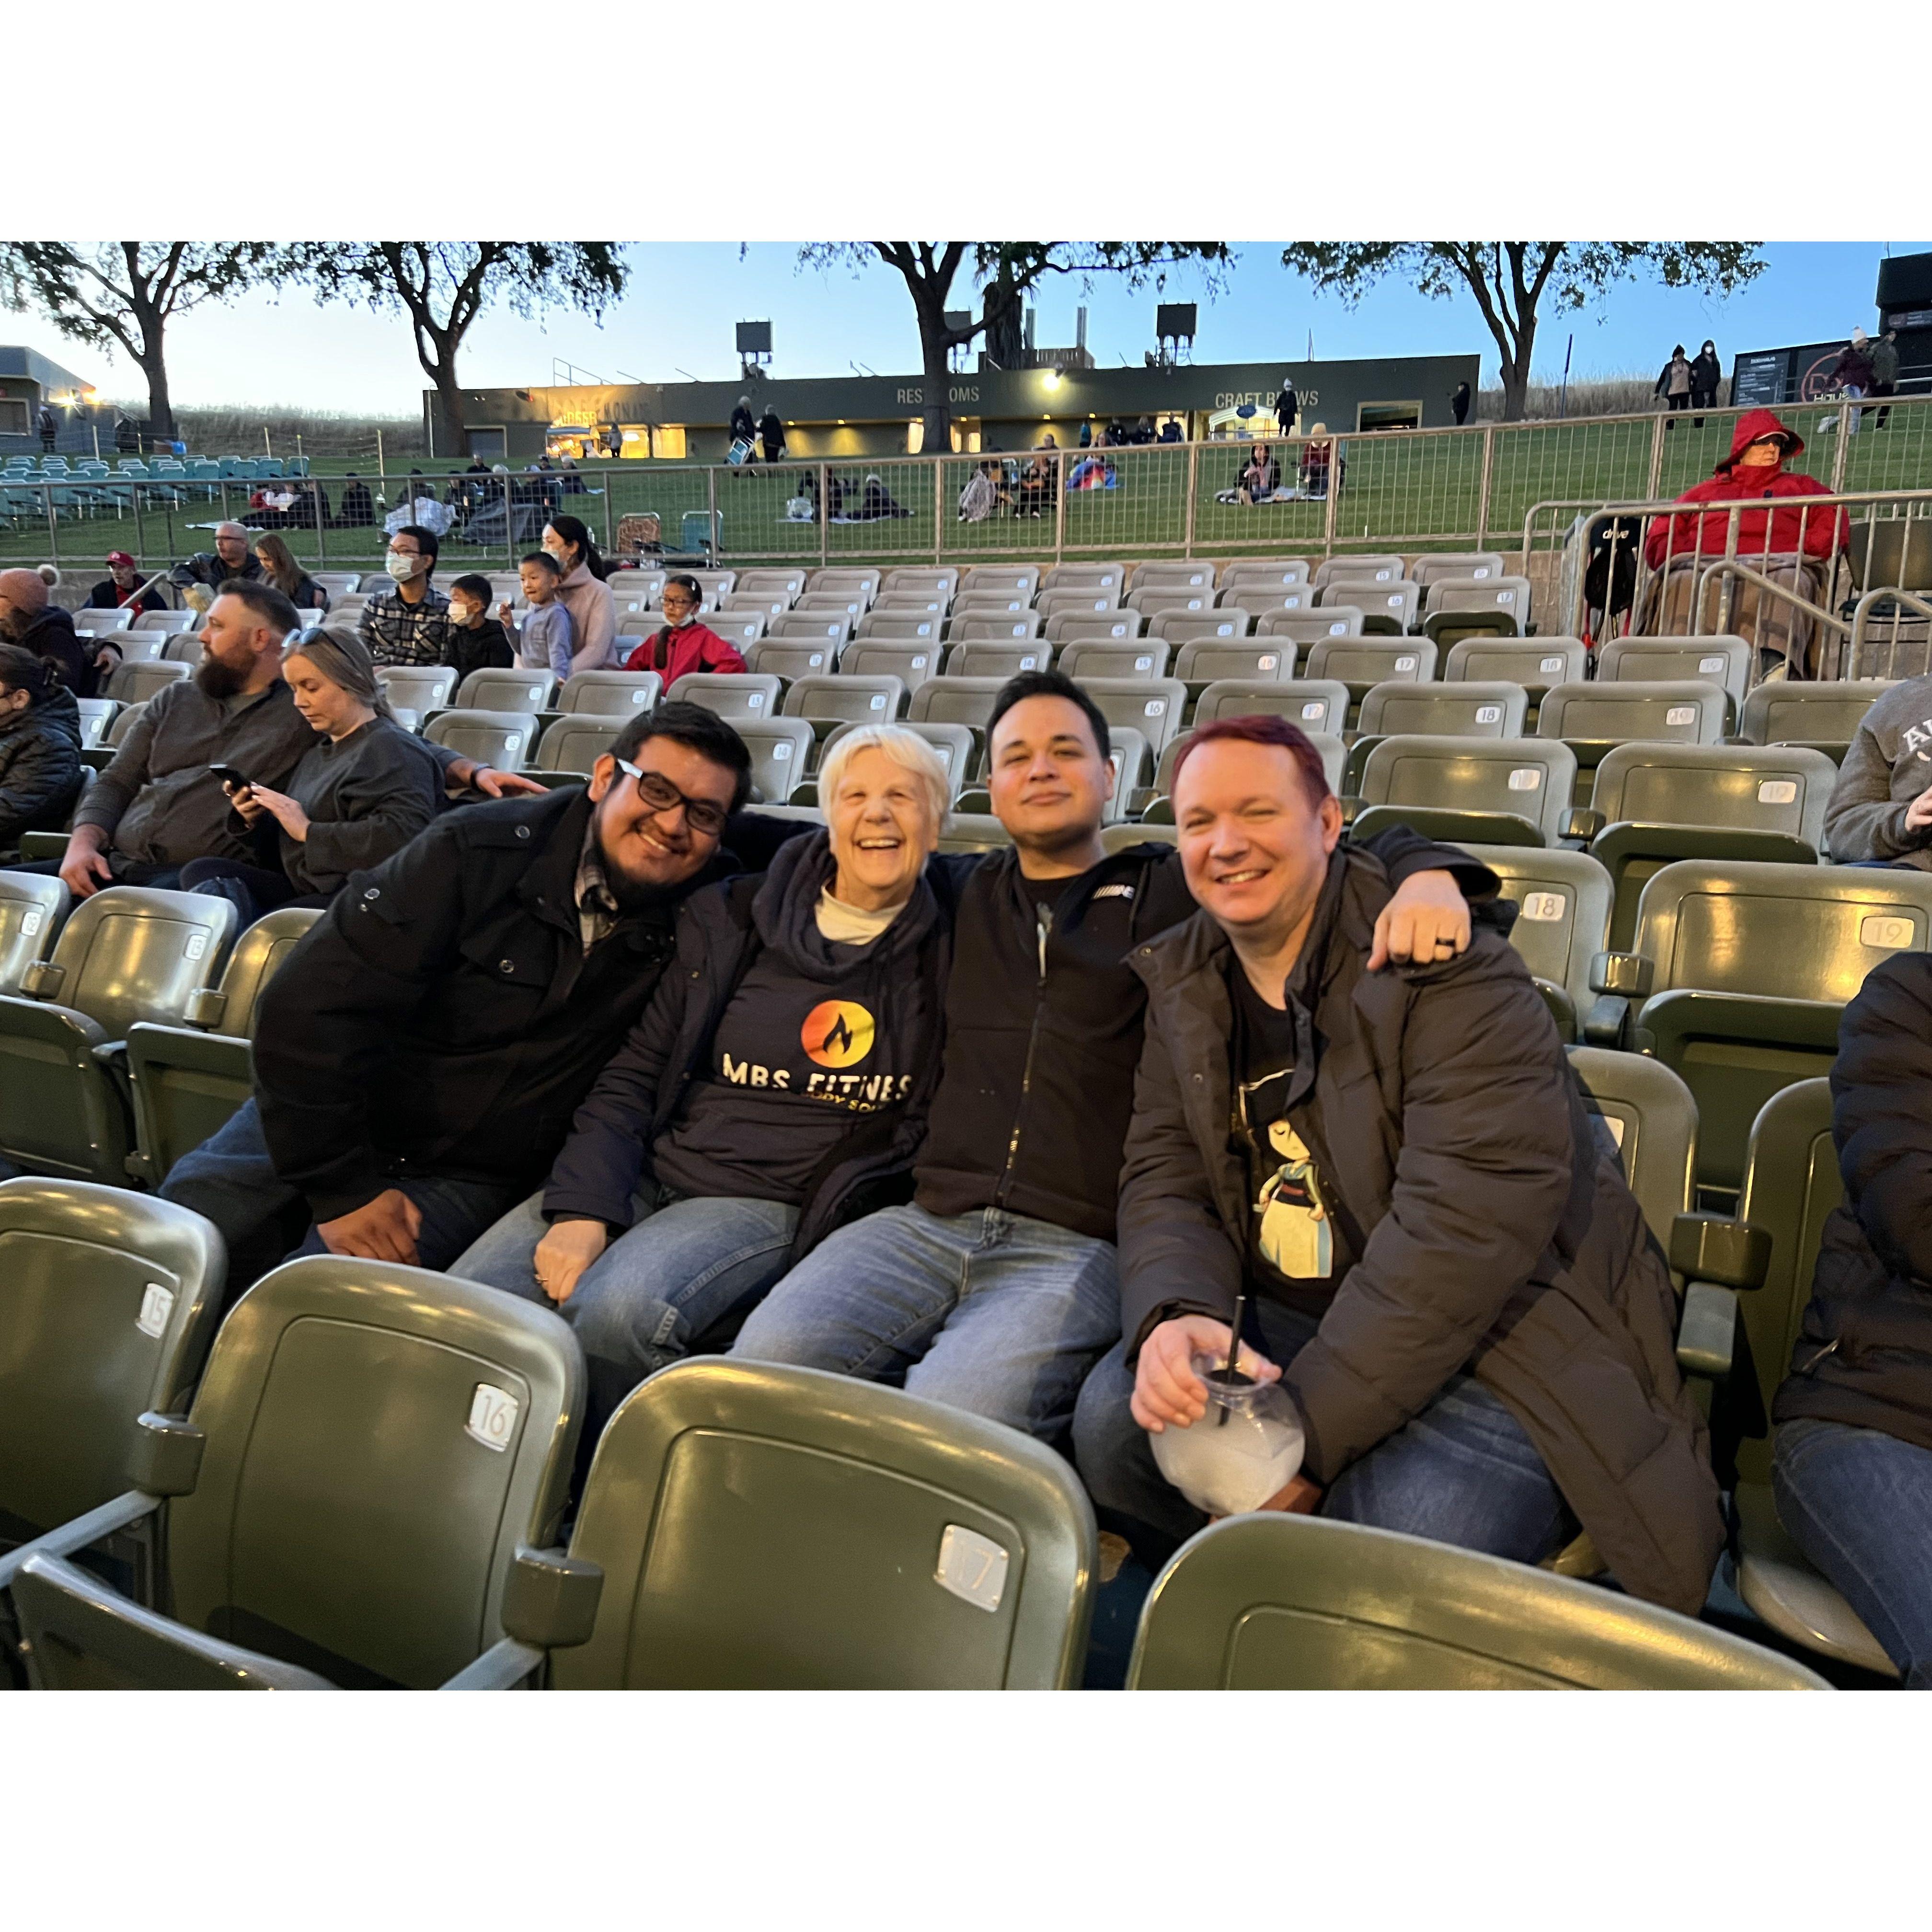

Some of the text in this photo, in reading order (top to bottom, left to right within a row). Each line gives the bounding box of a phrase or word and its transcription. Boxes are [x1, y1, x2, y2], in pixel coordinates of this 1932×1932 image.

[1215, 390, 1319, 409] CRAFT BWS
[1400, 659, 1411, 669] 17
[1150, 702, 1160, 713] 16
[1308, 705, 1319, 717] 17
[1482, 709, 1494, 721] 18
[1535, 897, 1555, 917] 18
[1875, 921, 1903, 943] 19
[723, 1053, 791, 1089] MBS
[150, 1291, 168, 1327] 15
[481, 1395, 507, 1437] 16
[958, 1539, 994, 1591] 17
